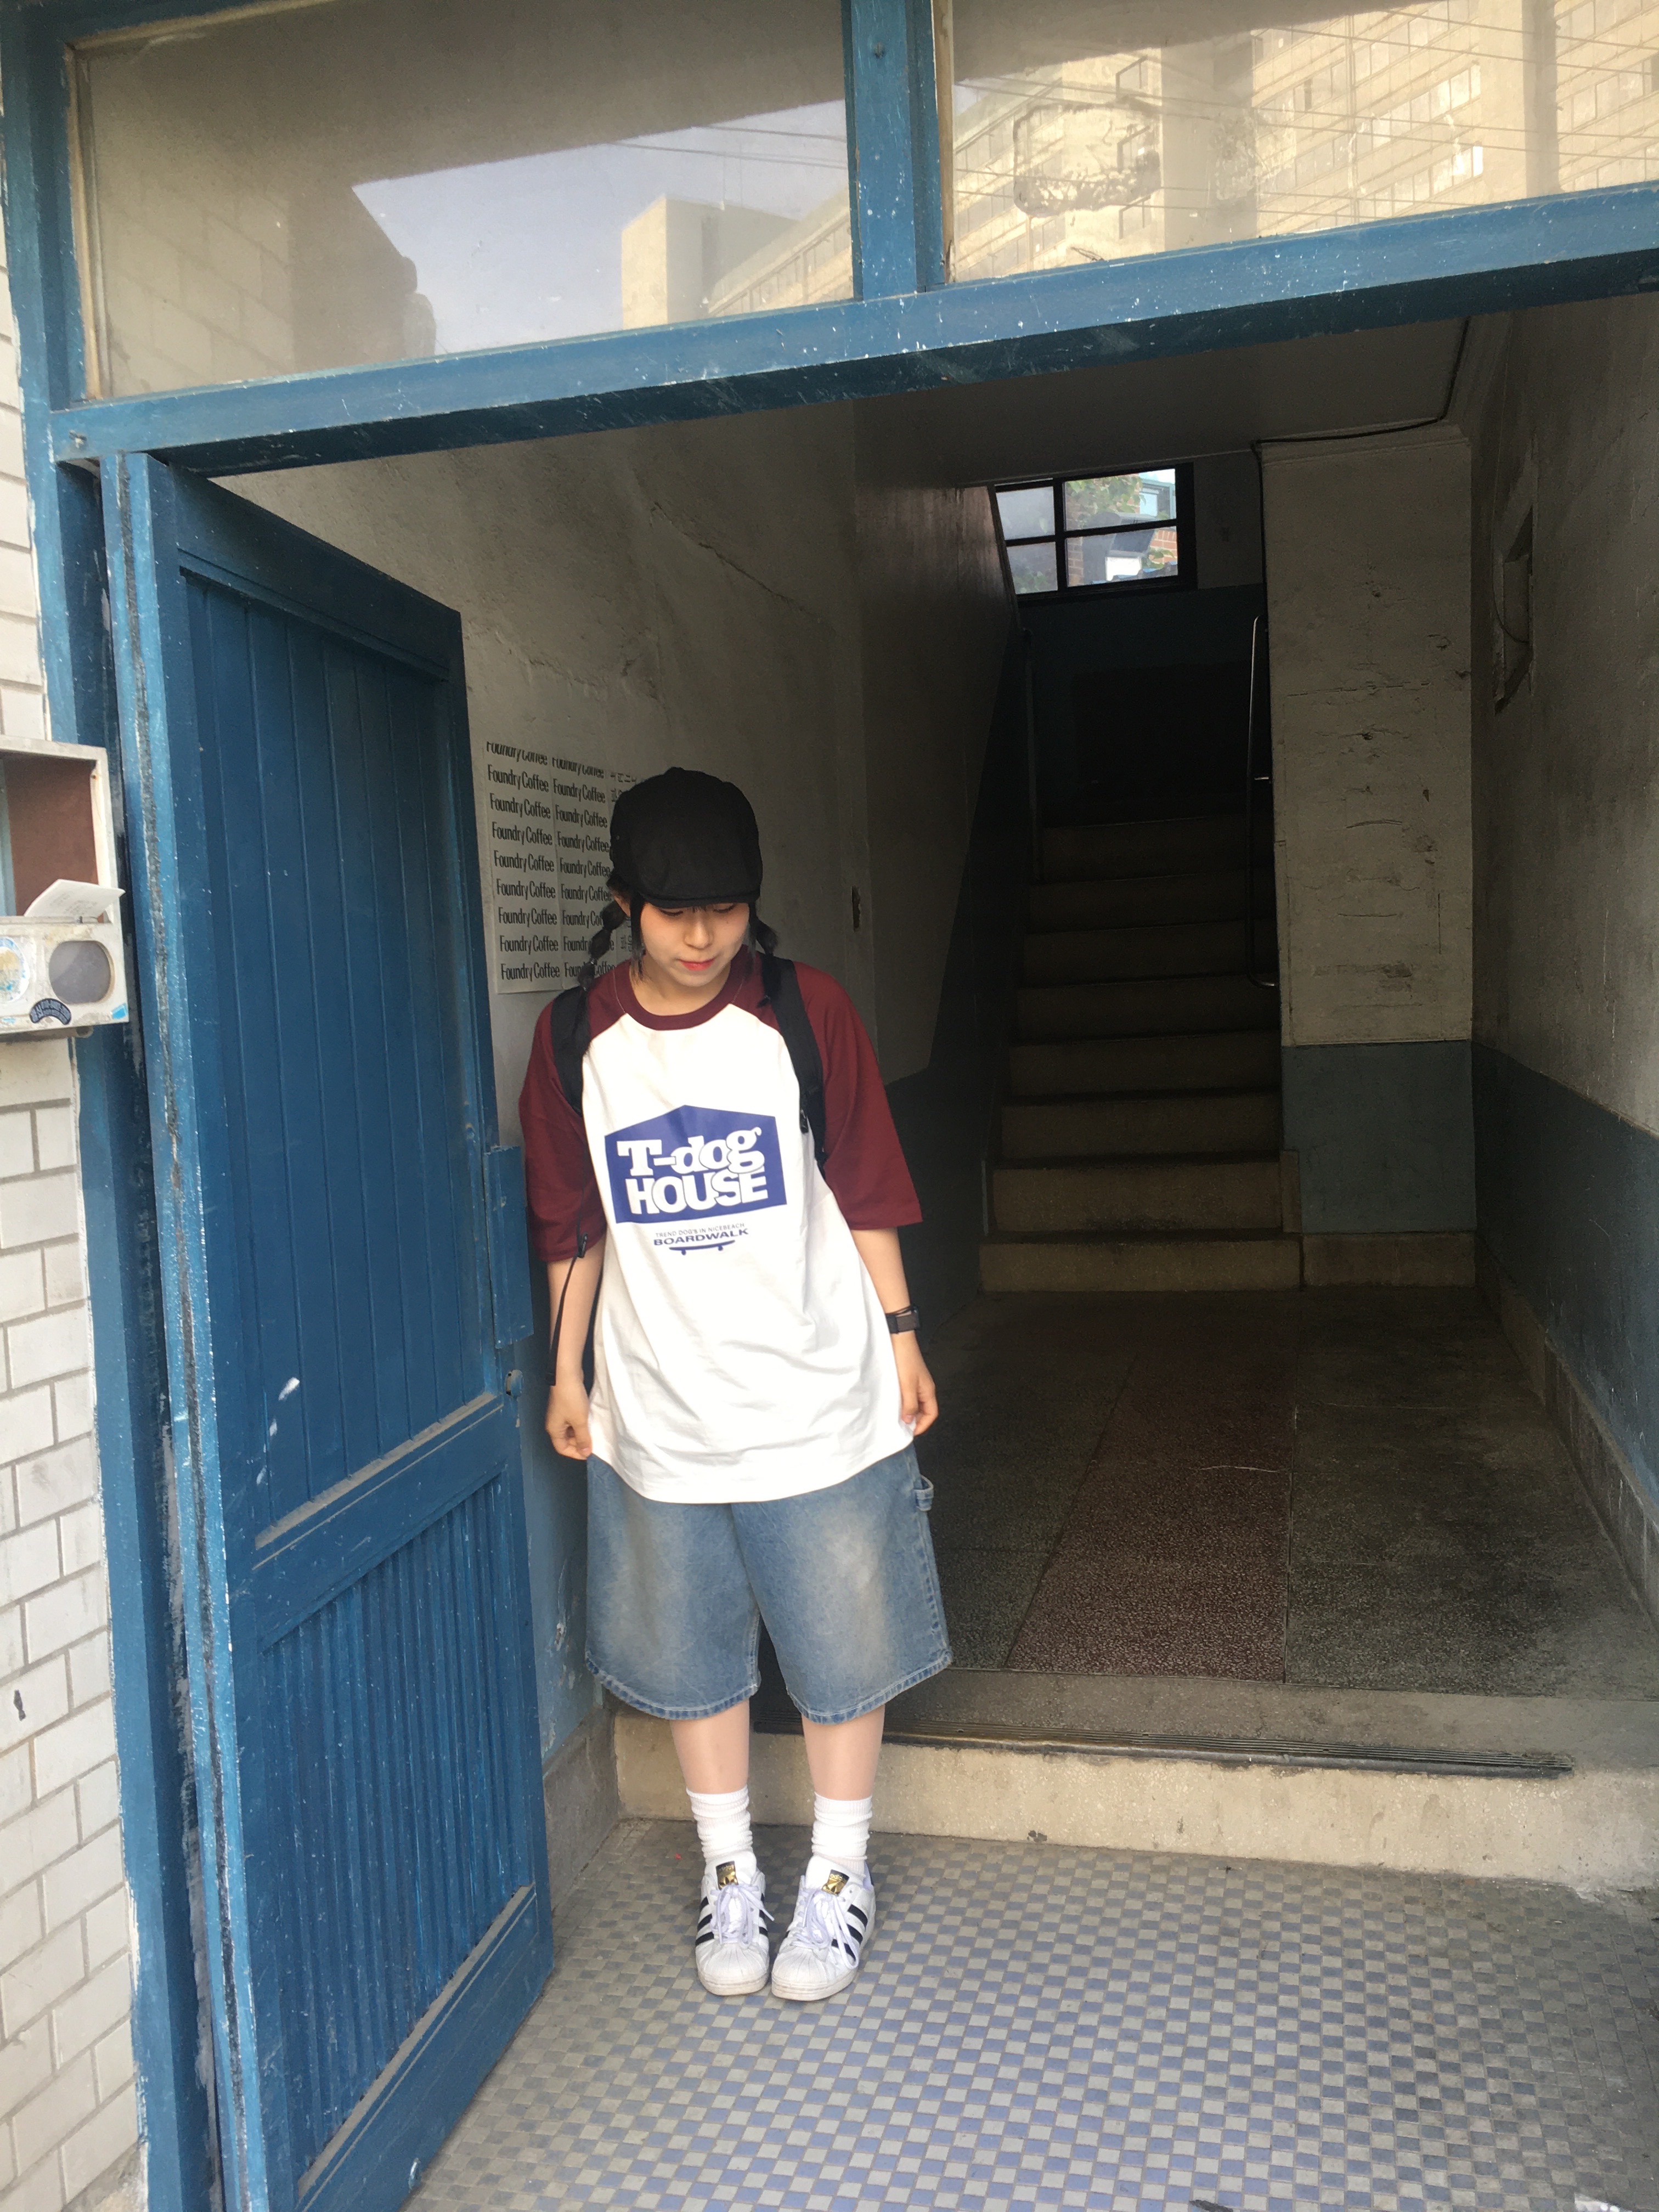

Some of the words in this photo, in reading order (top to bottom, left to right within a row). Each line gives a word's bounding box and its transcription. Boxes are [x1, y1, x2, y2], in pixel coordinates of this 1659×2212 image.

[488, 764, 521, 790] Foundry
[522, 771, 549, 793] Coffee
[553, 778, 582, 803] Foundry
[582, 784, 606, 803] Coffee
[490, 793, 523, 818] Foundry
[523, 799, 551, 819] Coffee
[555, 804, 583, 828] Foundry
[584, 809, 608, 828] Coffee
[492, 821, 524, 845] Foundry
[526, 826, 553, 845] Coffee
[557, 831, 585, 853] Foundry
[585, 834, 610, 853] Coffee
[494, 850, 527, 872] Foundry
[528, 853, 555, 872] Coffee
[560, 857, 587, 878] Foundry
[588, 860, 611, 878] Coffee
[496, 878, 528, 900] Foundry
[529, 881, 556, 899] Coffee
[561, 883, 588, 904] Foundry
[498, 907, 531, 928] Foundry
[531, 908, 557, 926] Coffee
[562, 910, 589, 929] Foundry
[500, 935, 532, 955] Foundry
[533, 934, 559, 952] Coffee
[501, 963, 533, 982] Foundry
[533, 962, 560, 979] Coffee
[617, 1127, 765, 1176] T-dog
[625, 1166, 768, 1214] HOUSE
[654, 1228, 749, 1246] BOARDWALK
[656, 1230, 677, 1238] TREND
[708, 1223, 745, 1232] NICEBEACH
